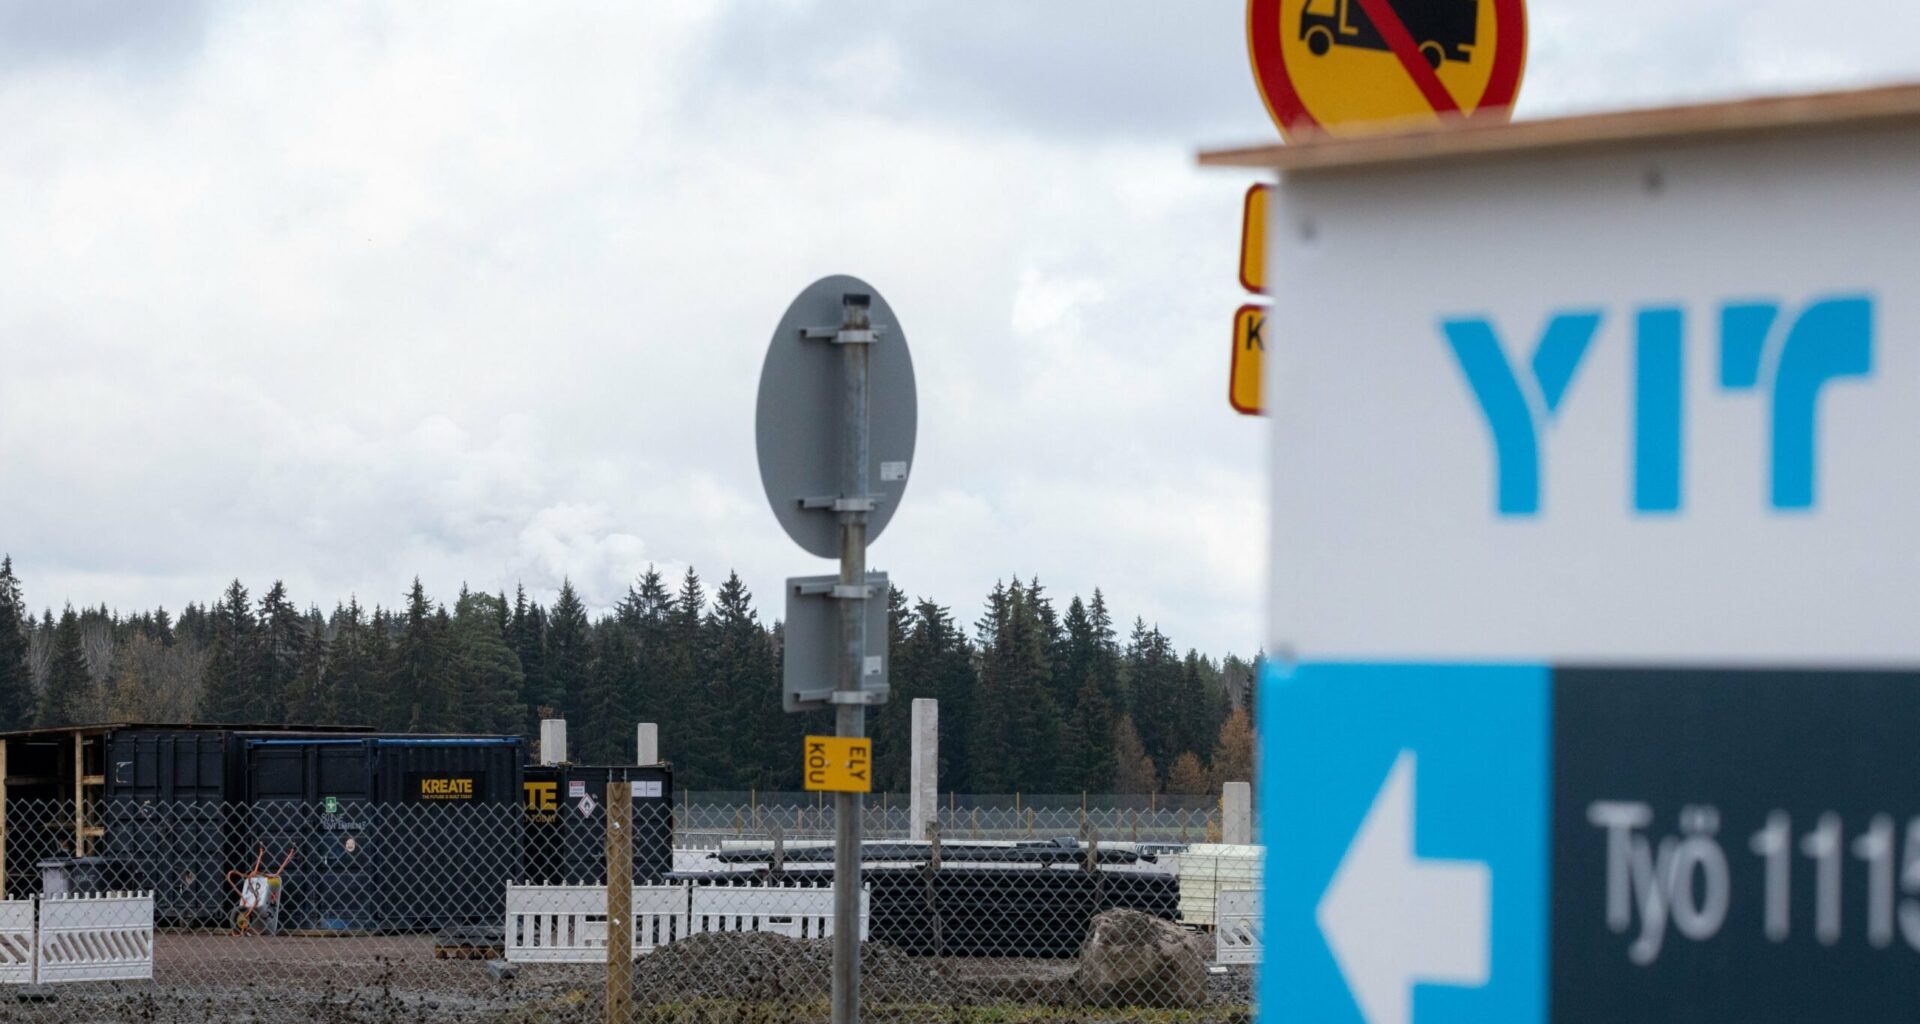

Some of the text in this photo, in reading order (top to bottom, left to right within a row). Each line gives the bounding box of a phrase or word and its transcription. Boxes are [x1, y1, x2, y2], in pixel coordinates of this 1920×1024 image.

[1246, 314, 1268, 351] K
[1440, 295, 1874, 516] YIT
[808, 742, 825, 784] KOU
[849, 746, 866, 781] ELY
[421, 779, 472, 793] KREATE
[523, 782, 557, 810] TE
[1587, 800, 1731, 966] Työ
